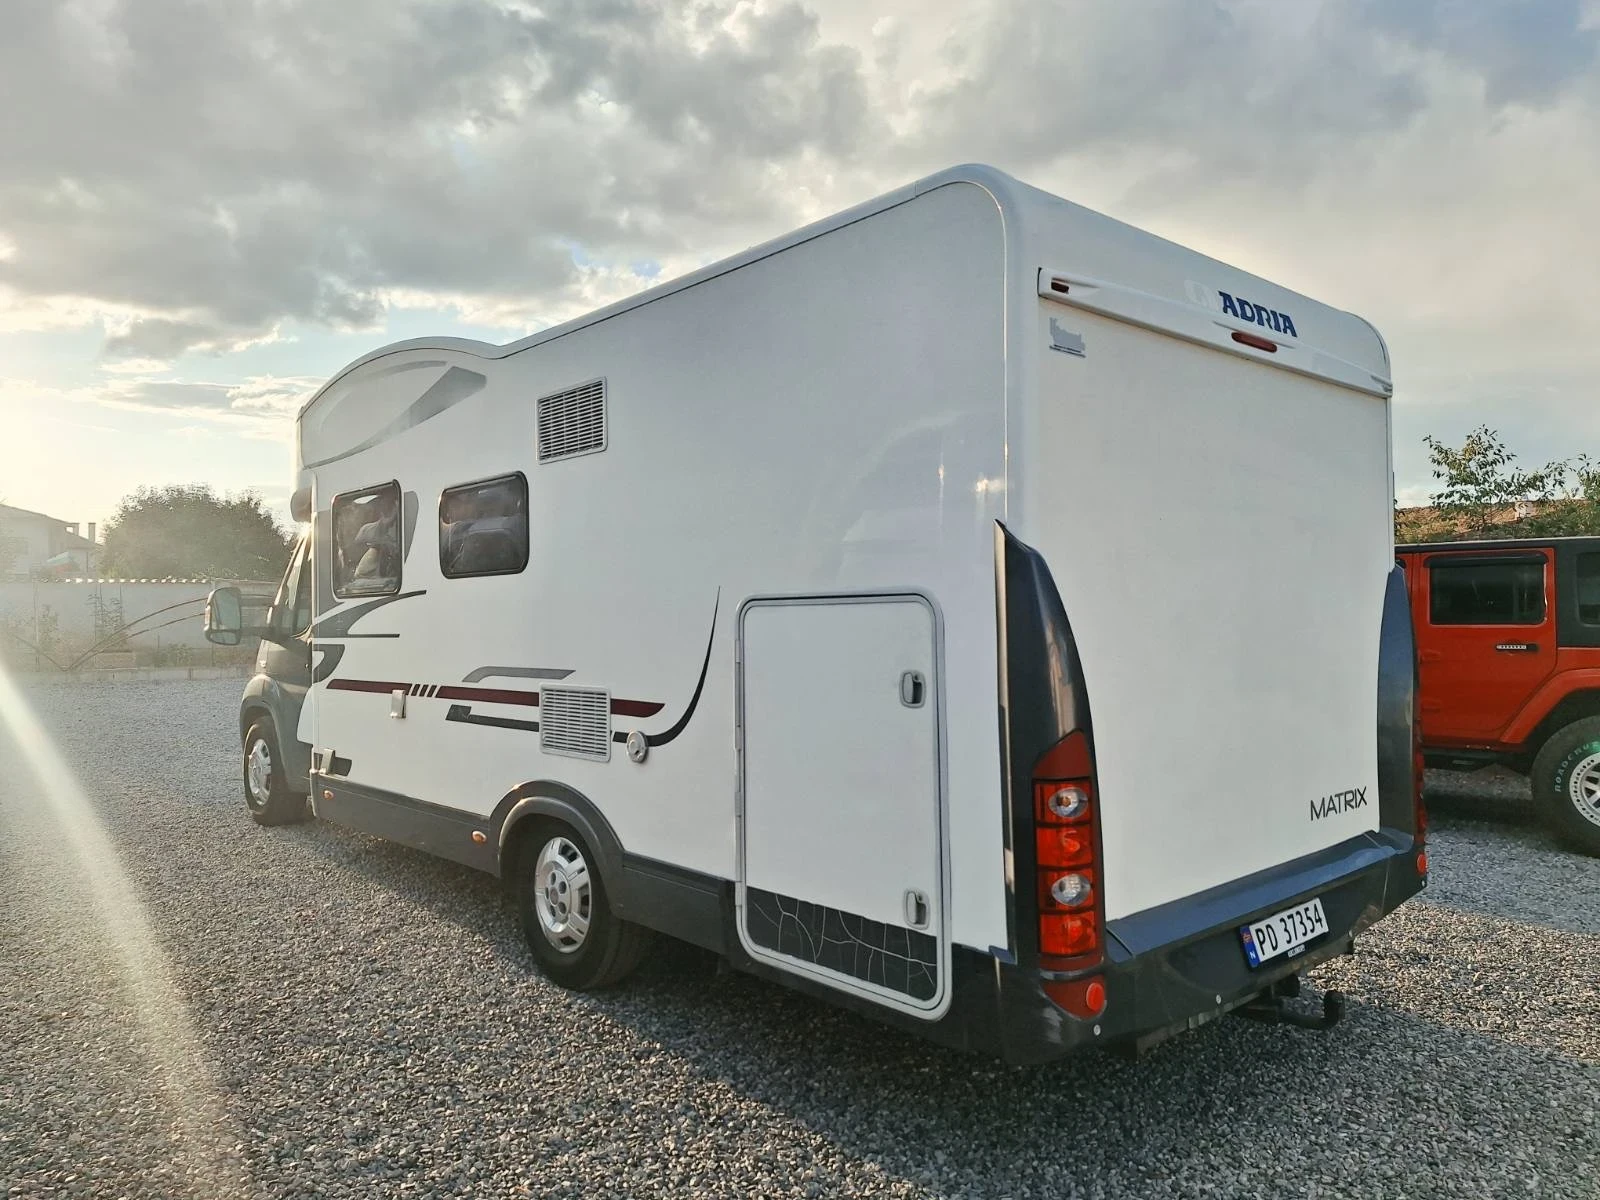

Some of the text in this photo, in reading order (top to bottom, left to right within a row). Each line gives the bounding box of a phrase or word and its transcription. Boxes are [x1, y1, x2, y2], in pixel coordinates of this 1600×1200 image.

[1218, 291, 1297, 337] ADRIA
[1310, 786, 1367, 821] MATRIX
[1255, 903, 1324, 956] PD 37354
